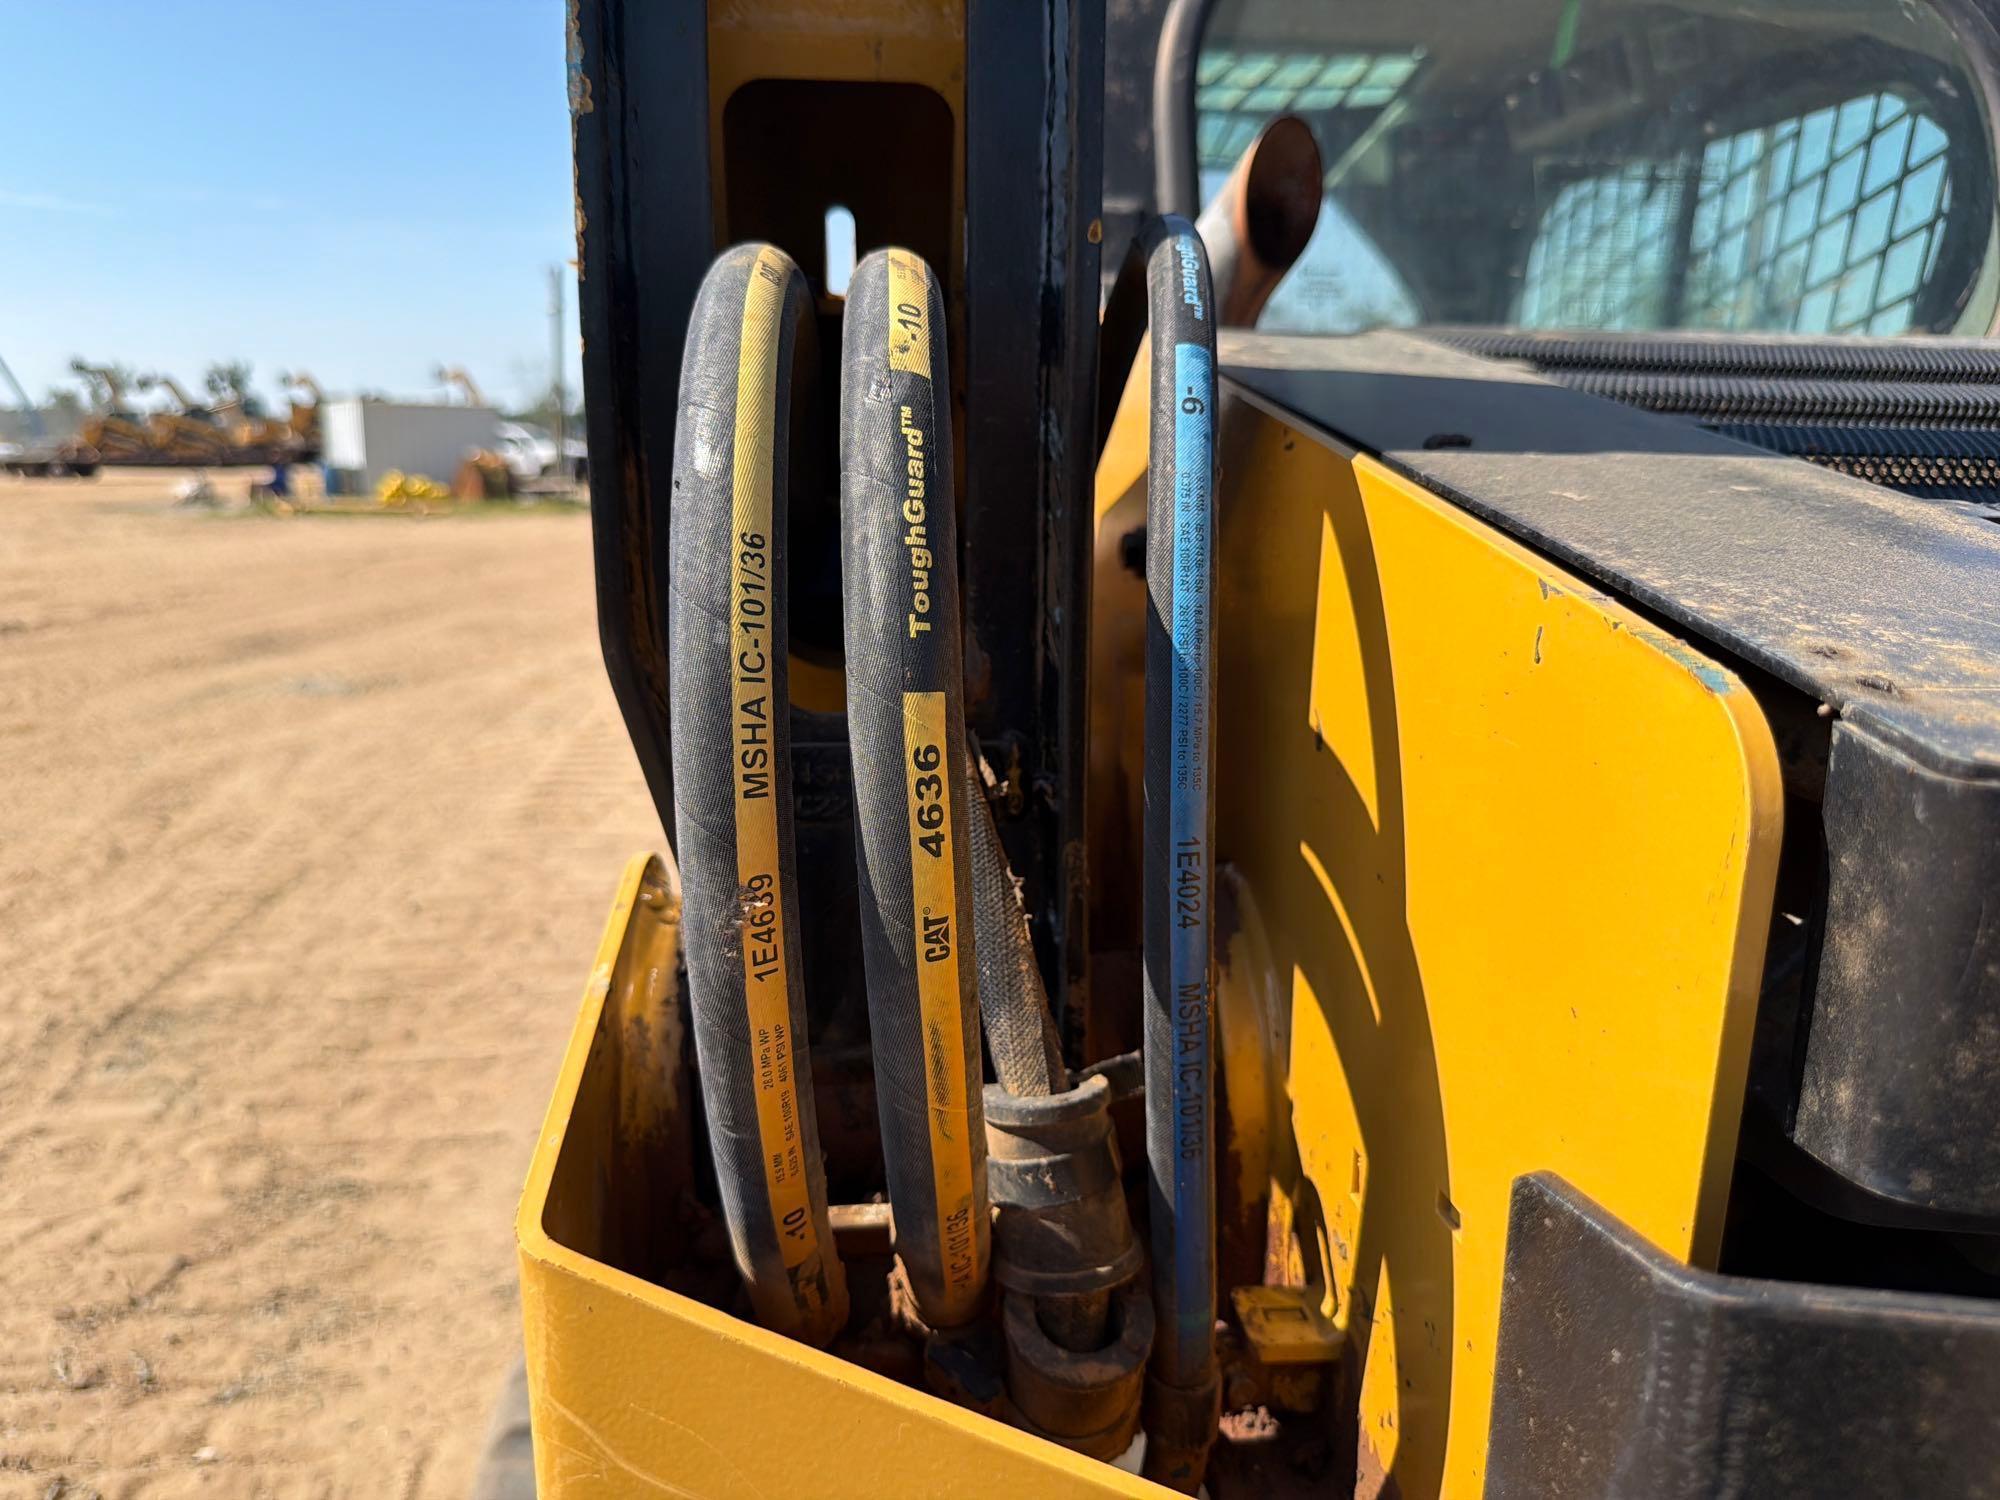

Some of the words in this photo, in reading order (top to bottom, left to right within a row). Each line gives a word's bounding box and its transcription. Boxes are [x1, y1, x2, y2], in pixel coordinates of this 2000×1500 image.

[897, 303, 923, 341] -10
[1181, 386, 1206, 415] -6
[1180, 522, 1190, 543] SAE
[739, 532, 767, 684] IC-101/36
[1179, 632, 1188, 650] PSI
[1194, 628, 1203, 650] MPa
[1178, 667, 1188, 692] 100C
[1194, 667, 1203, 692] 100C
[1178, 702, 1188, 726] 2277
[740, 696, 769, 799] MSHA
[1178, 730, 1188, 748] PSI
[1193, 727, 1202, 749] MPa
[1178, 750, 1187, 760] to
[1193, 752, 1202, 763] to
[1177, 765, 1187, 790] 135C
[1192, 767, 1202, 792] 135C
[913, 744, 946, 858] 4636
[1177, 836, 1201, 929] 1E4024
[747, 873, 779, 983] 1E4639
[1178, 982, 1201, 1056] MSHA
[758, 1028, 770, 1046] WP
[774, 1023, 785, 1042] WP
[760, 1046, 772, 1068] MPa
[775, 1042, 787, 1061] PSI
[762, 1071, 774, 1091] 28.0
[777, 1060, 788, 1082] 4061
[1180, 1061, 1203, 1160] IC-101/36
[785, 1121, 795, 1142] SAE
[783, 1207, 808, 1240] -10
